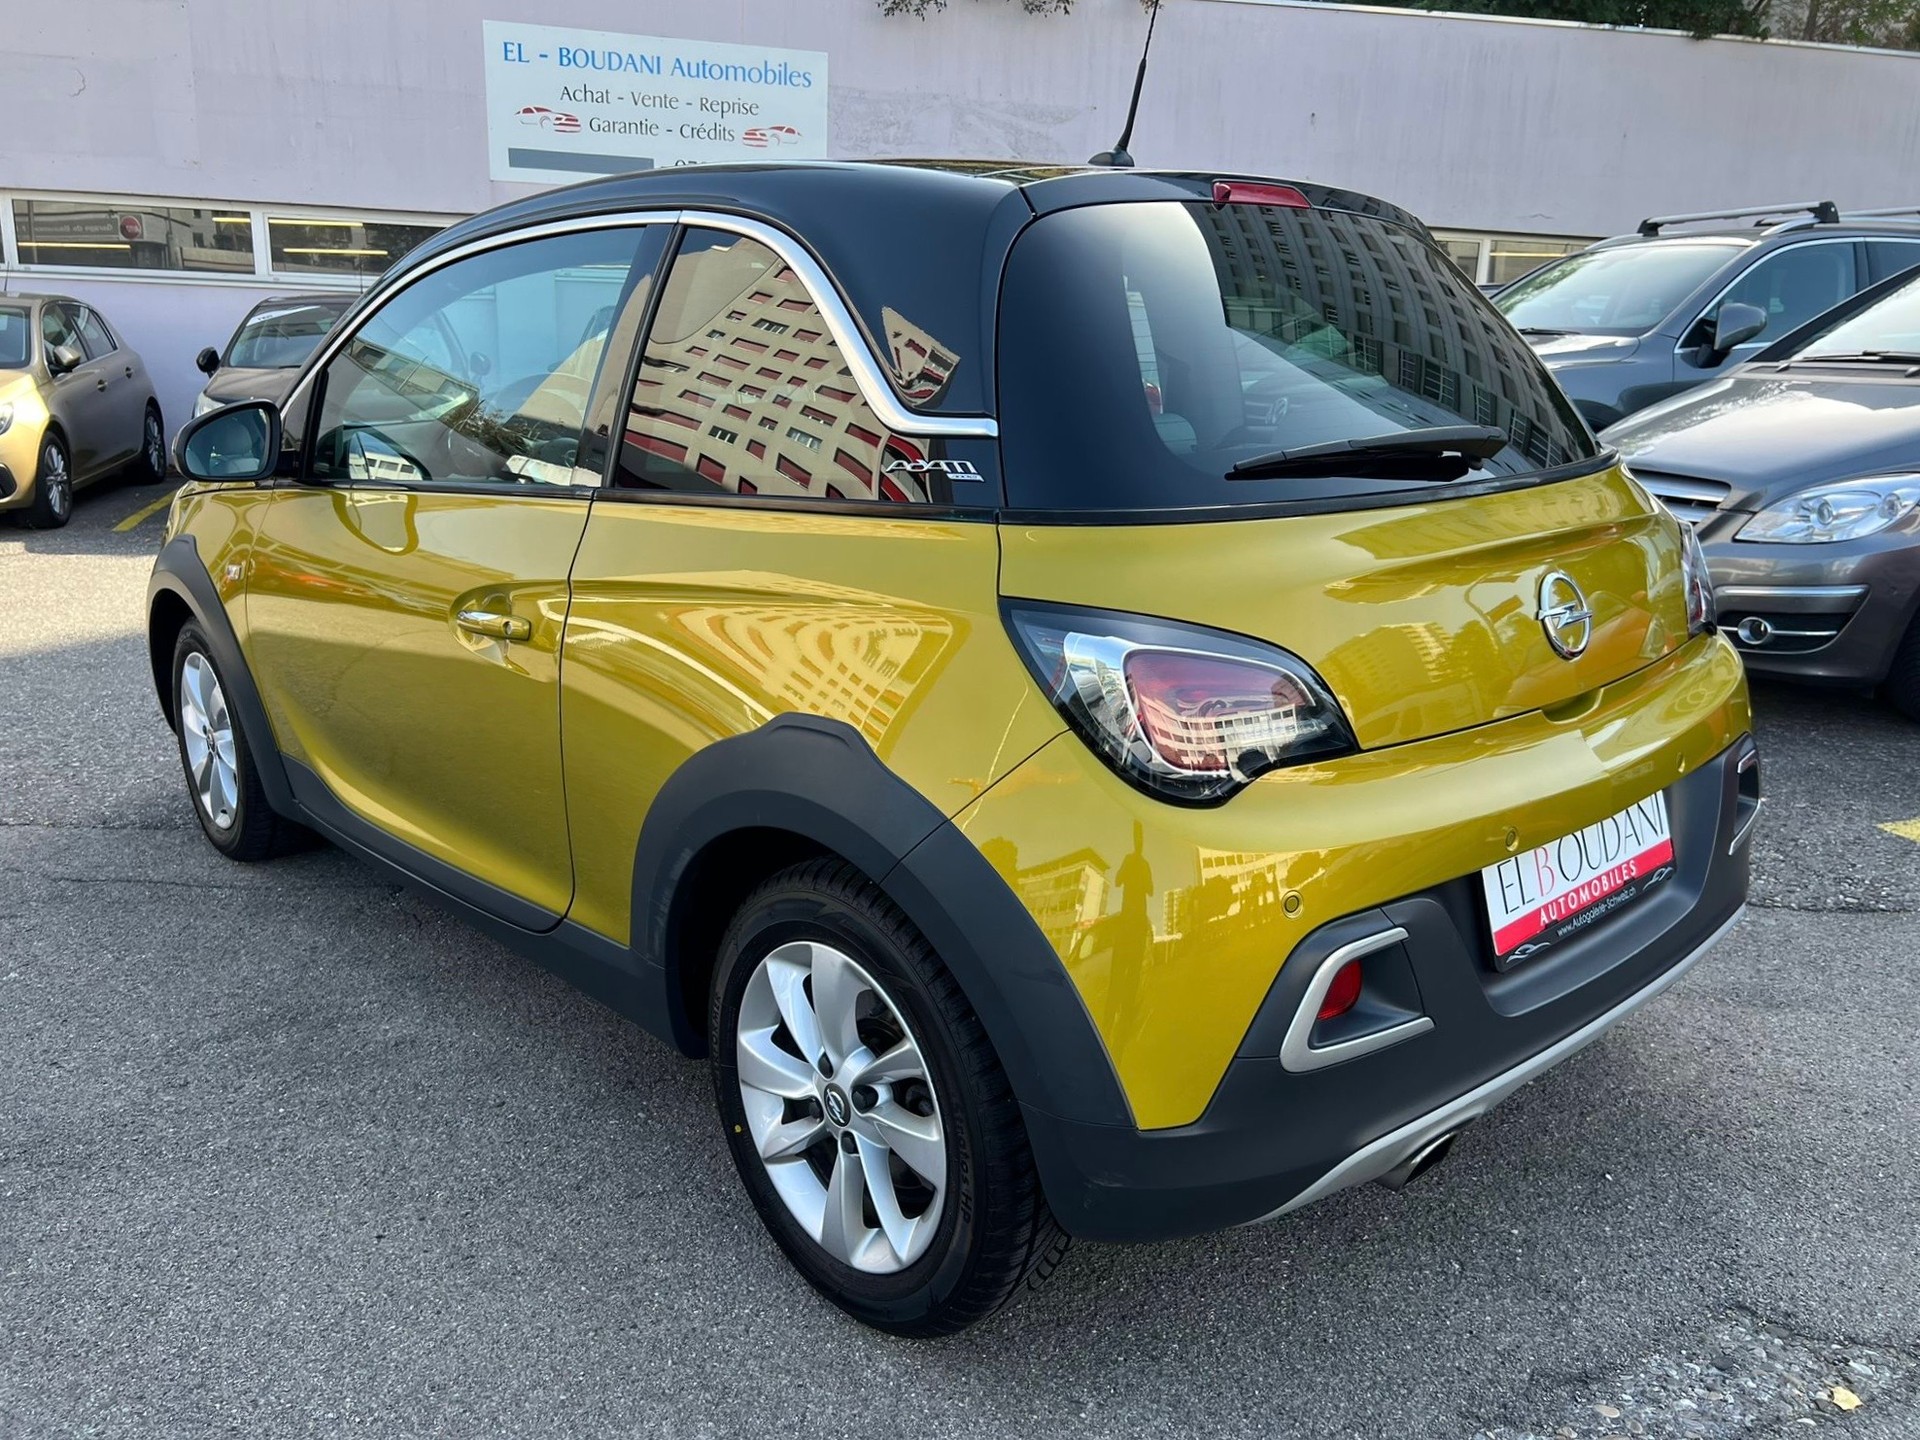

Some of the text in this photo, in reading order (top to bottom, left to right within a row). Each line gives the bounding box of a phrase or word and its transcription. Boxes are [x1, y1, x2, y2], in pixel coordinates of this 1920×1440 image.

[502, 41, 530, 63] EL
[558, 46, 662, 75] BOUDANI
[670, 57, 813, 89] Automobiles
[560, 84, 611, 105] Achat
[630, 91, 680, 110] Vente
[700, 97, 760, 119] Reprise
[588, 117, 660, 137] Garantie
[679, 122, 736, 143] Crédits
[1540, 860, 1638, 926] AUTOMOBILES
